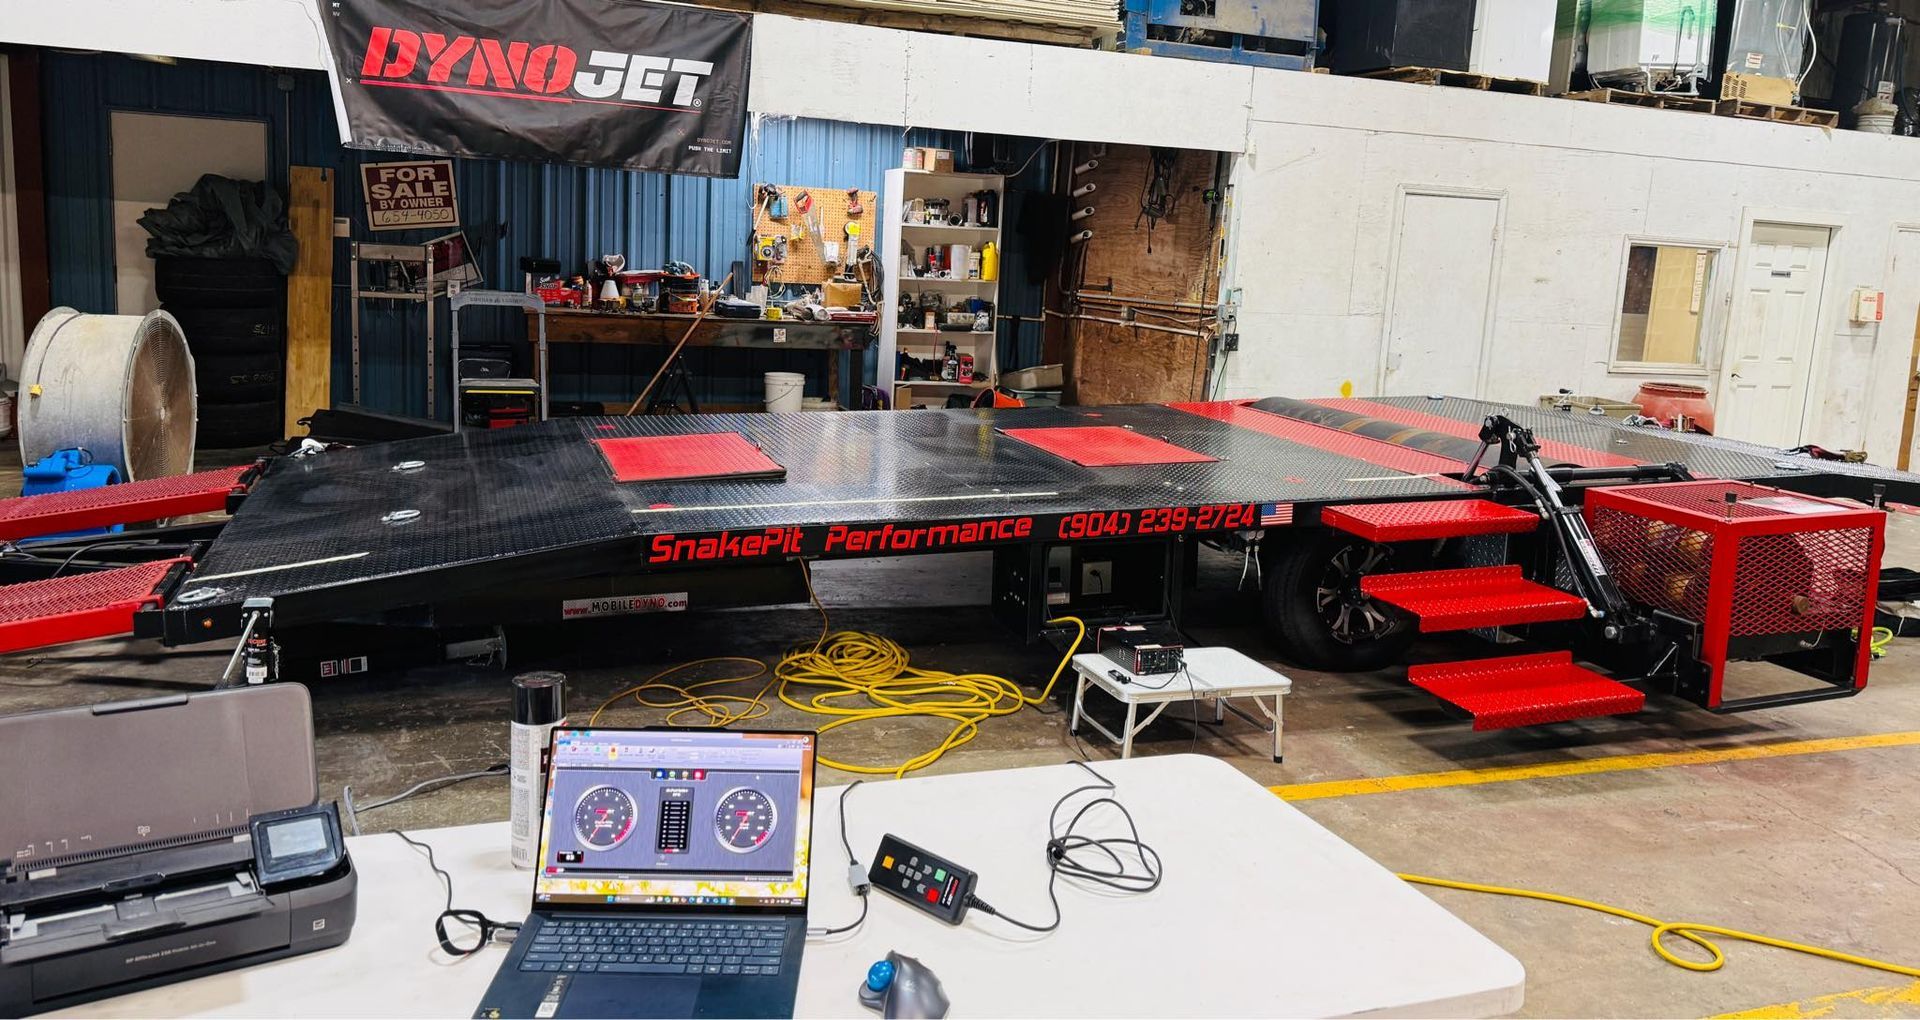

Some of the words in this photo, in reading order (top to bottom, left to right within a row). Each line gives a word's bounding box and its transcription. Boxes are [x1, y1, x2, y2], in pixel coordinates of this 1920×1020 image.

[360, 26, 714, 107] DYNOJET
[379, 167, 436, 182] FOR
[371, 181, 450, 199] SALE
[380, 199, 396, 209] BY
[400, 197, 444, 208] OWNER
[381, 209, 450, 223] 654-4050
[649, 526, 804, 563] SnakePit
[824, 517, 1033, 552] Performance
[1058, 511, 1131, 539] (904)
[1137, 501, 1256, 534] 239-2724
[563, 597, 688, 616] www.MOBILEDYNO.com
